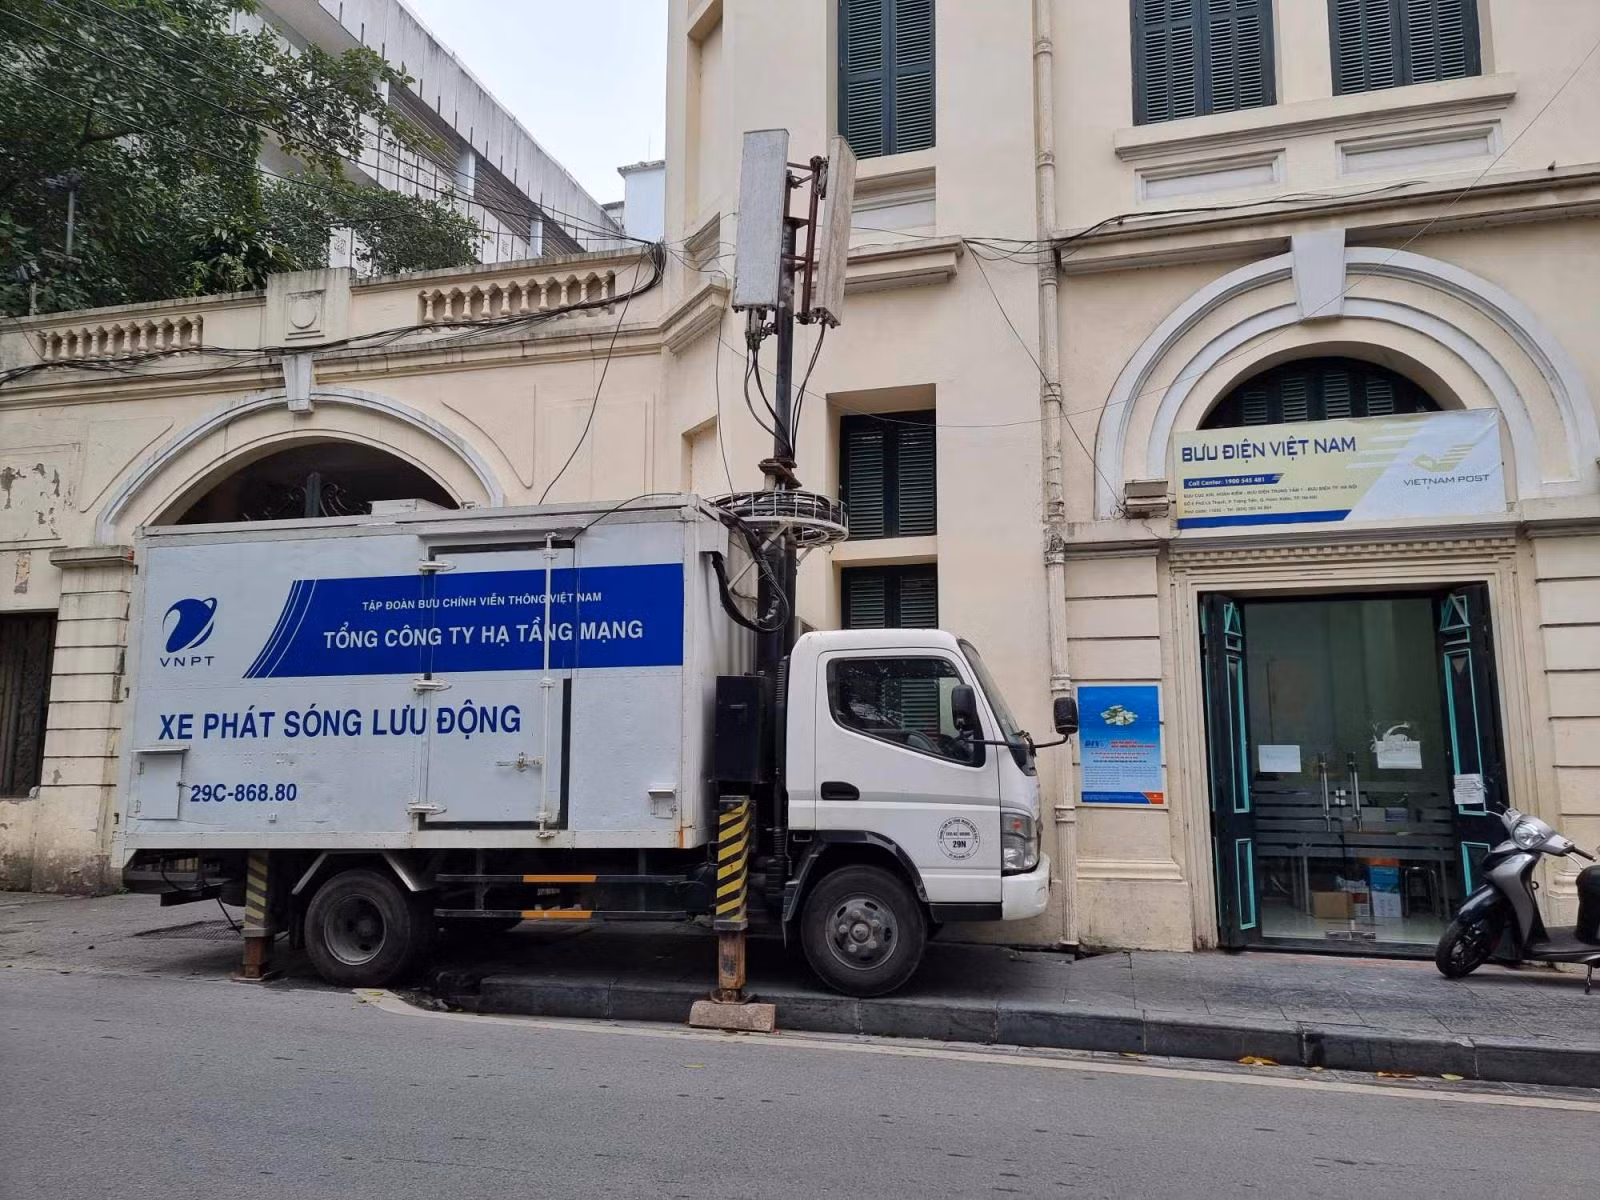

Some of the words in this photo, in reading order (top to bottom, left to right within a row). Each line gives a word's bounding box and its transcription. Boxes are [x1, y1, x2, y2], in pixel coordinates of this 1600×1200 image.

[1182, 443, 1218, 462] BƯU
[1222, 438, 1266, 463] ĐIỆN
[1269, 435, 1310, 461] VIỆT
[1314, 436, 1357, 454] NAM
[1403, 476, 1455, 486] VIETNAM
[1458, 474, 1490, 482] POST
[362, 599, 382, 612] TẬP
[386, 598, 415, 610] ĐOÀN
[418, 598, 440, 608] BƯU
[443, 595, 476, 607] CHÍNH
[480, 592, 505, 606] VIỄN
[508, 593, 547, 605] THÔNG
[550, 592, 574, 604] VIỆT
[577, 592, 602, 602] NAM
[323, 621, 378, 649] TỔNG
[384, 624, 442, 647] CÔNG
[449, 626, 475, 644] TY
[481, 625, 510, 647] HẠ
[580, 620, 643, 643] MẠNG
[159, 655, 216, 668] VNPT
[158, 713, 194, 740] XE
[203, 705, 275, 739] PHÁT
[283, 703, 362, 738] SÓNG
[372, 704, 427, 736] LƯU
[436, 698, 521, 740] ĐỘNG
[190, 783, 297, 803] 29C-868.80
[953, 840, 966, 848] 29N
